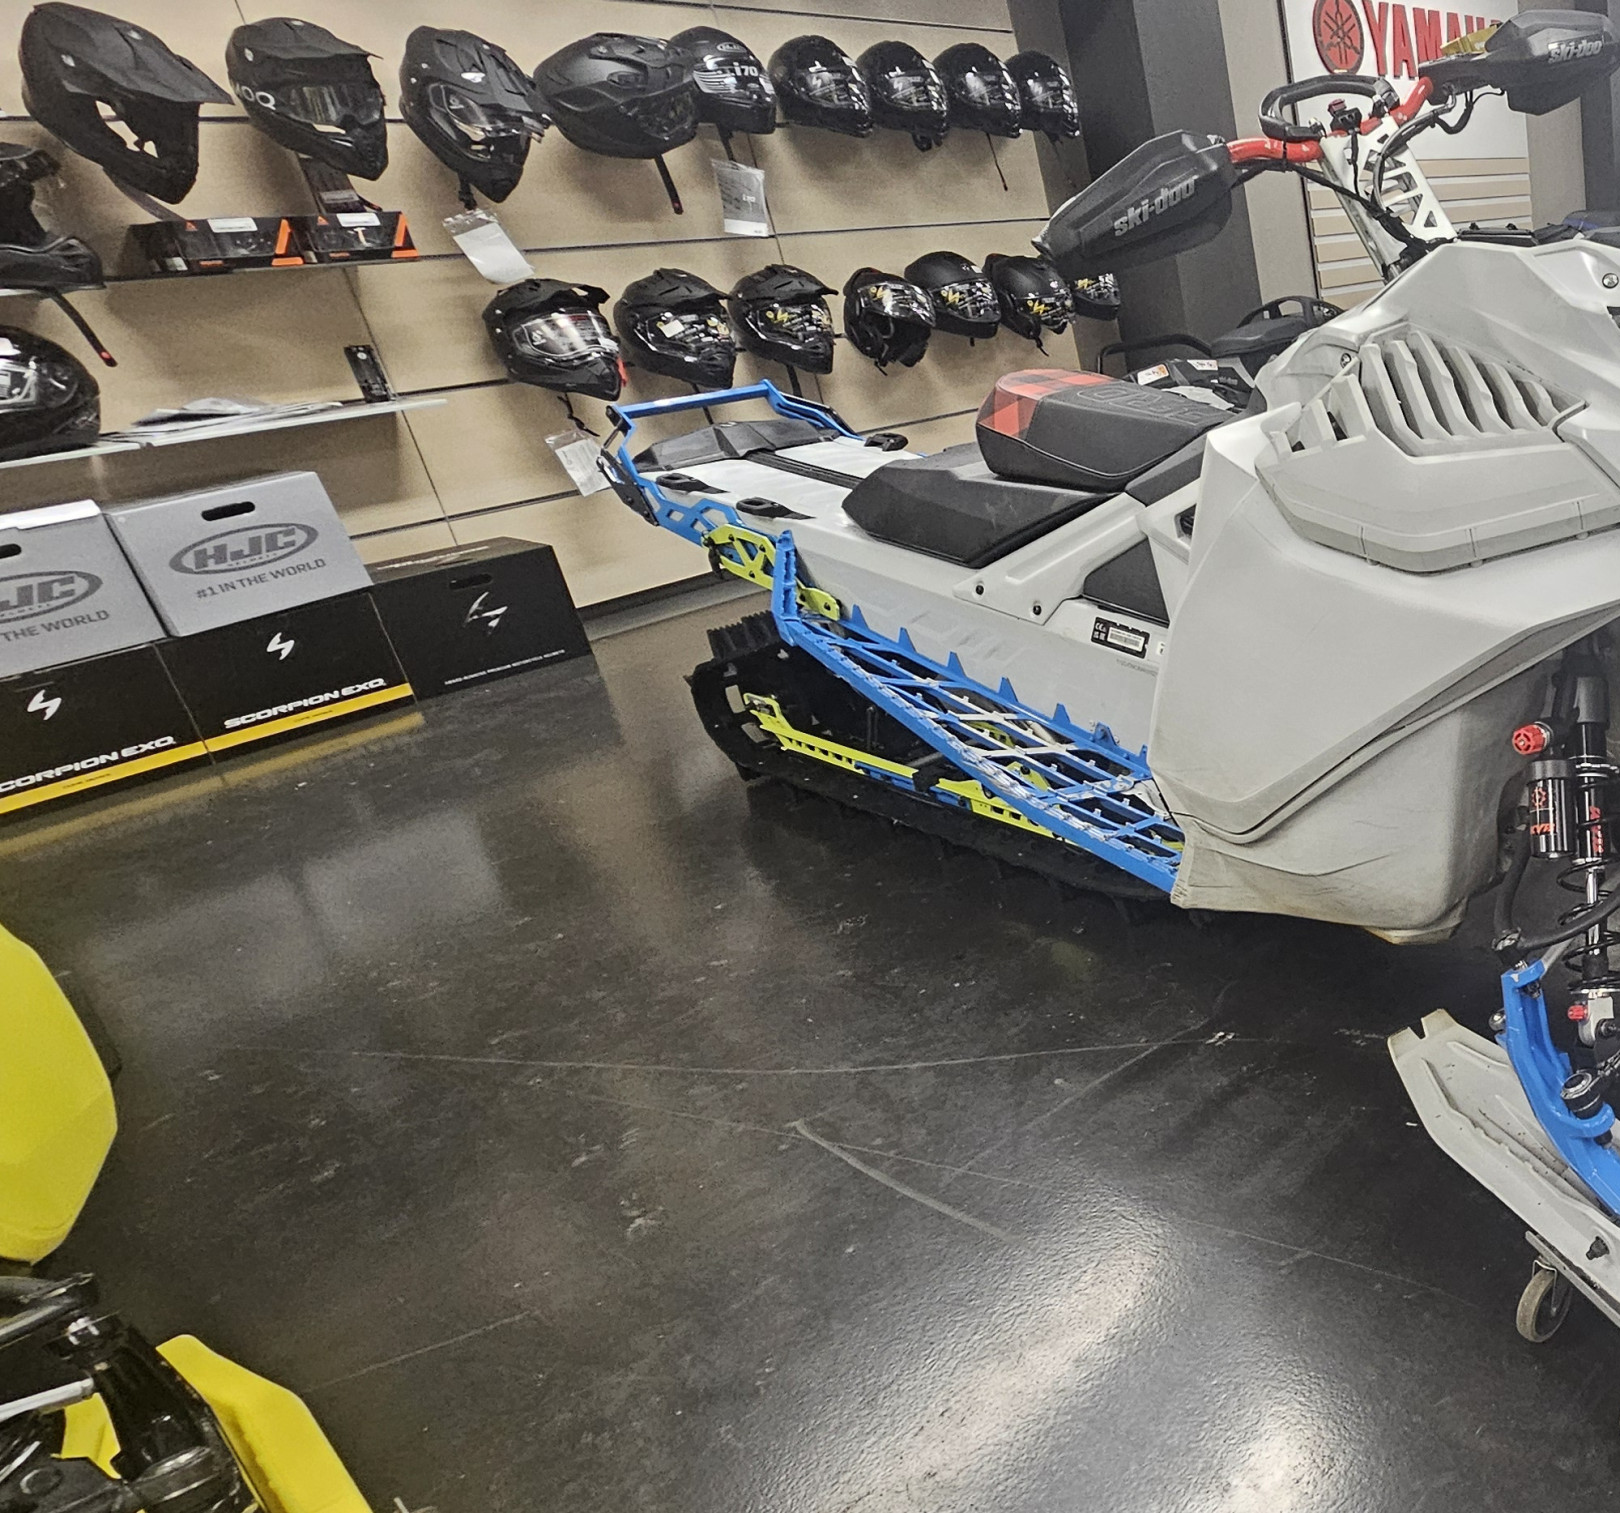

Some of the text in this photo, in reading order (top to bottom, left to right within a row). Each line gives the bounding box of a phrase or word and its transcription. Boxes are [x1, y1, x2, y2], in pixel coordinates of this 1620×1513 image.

[1362, 0, 1501, 80] YAMA
[1114, 175, 1198, 237] ski-doo
[194, 527, 296, 570] HJC
[0, 576, 75, 612] JC
[196, 586, 220, 599] #1
[218, 581, 237, 594] IN
[236, 573, 269, 588] THE
[270, 558, 327, 580] WORLD
[0, 625, 40, 642] THE
[41, 610, 110, 632] WORLD
[224, 690, 340, 729] SCORPION
[0, 751, 120, 793] CORPION
